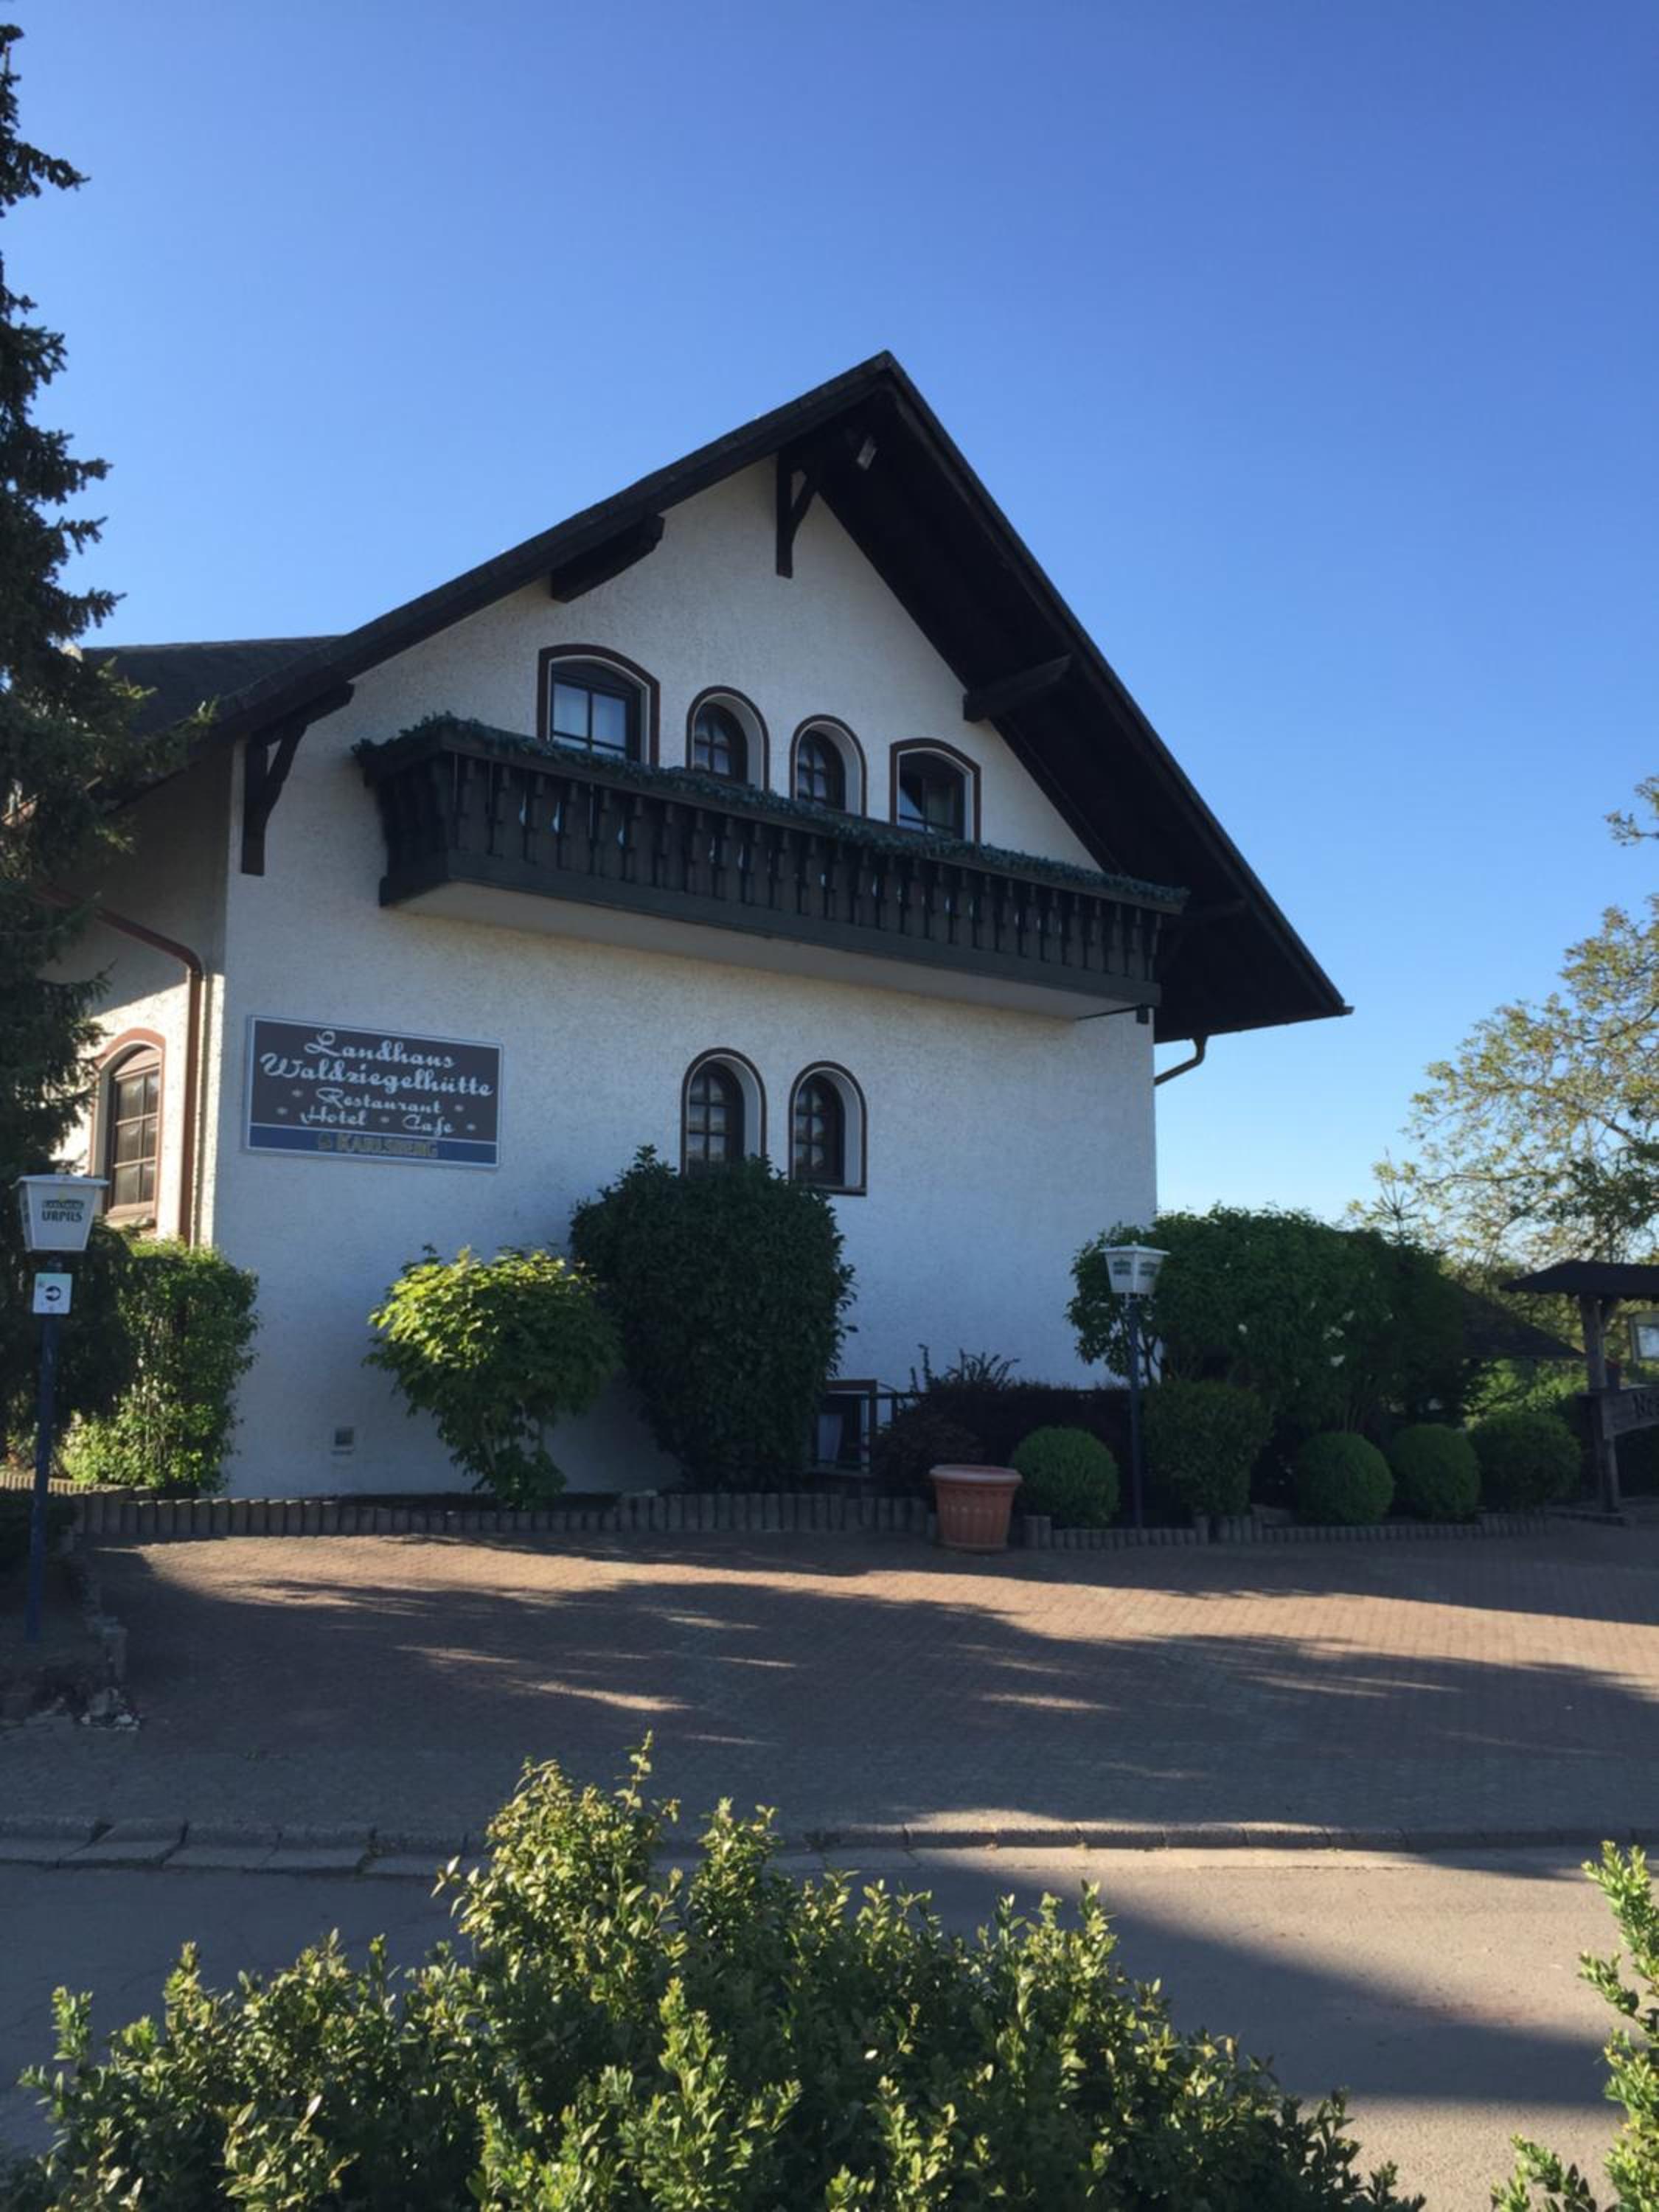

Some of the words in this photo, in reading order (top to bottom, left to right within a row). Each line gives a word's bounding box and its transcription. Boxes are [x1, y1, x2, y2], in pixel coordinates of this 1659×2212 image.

[304, 1031, 456, 1068] Landhaus
[260, 1052, 494, 1096] Waldziegelhütte
[300, 1105, 366, 1126] Hotel
[316, 1088, 441, 1114] Restaurant
